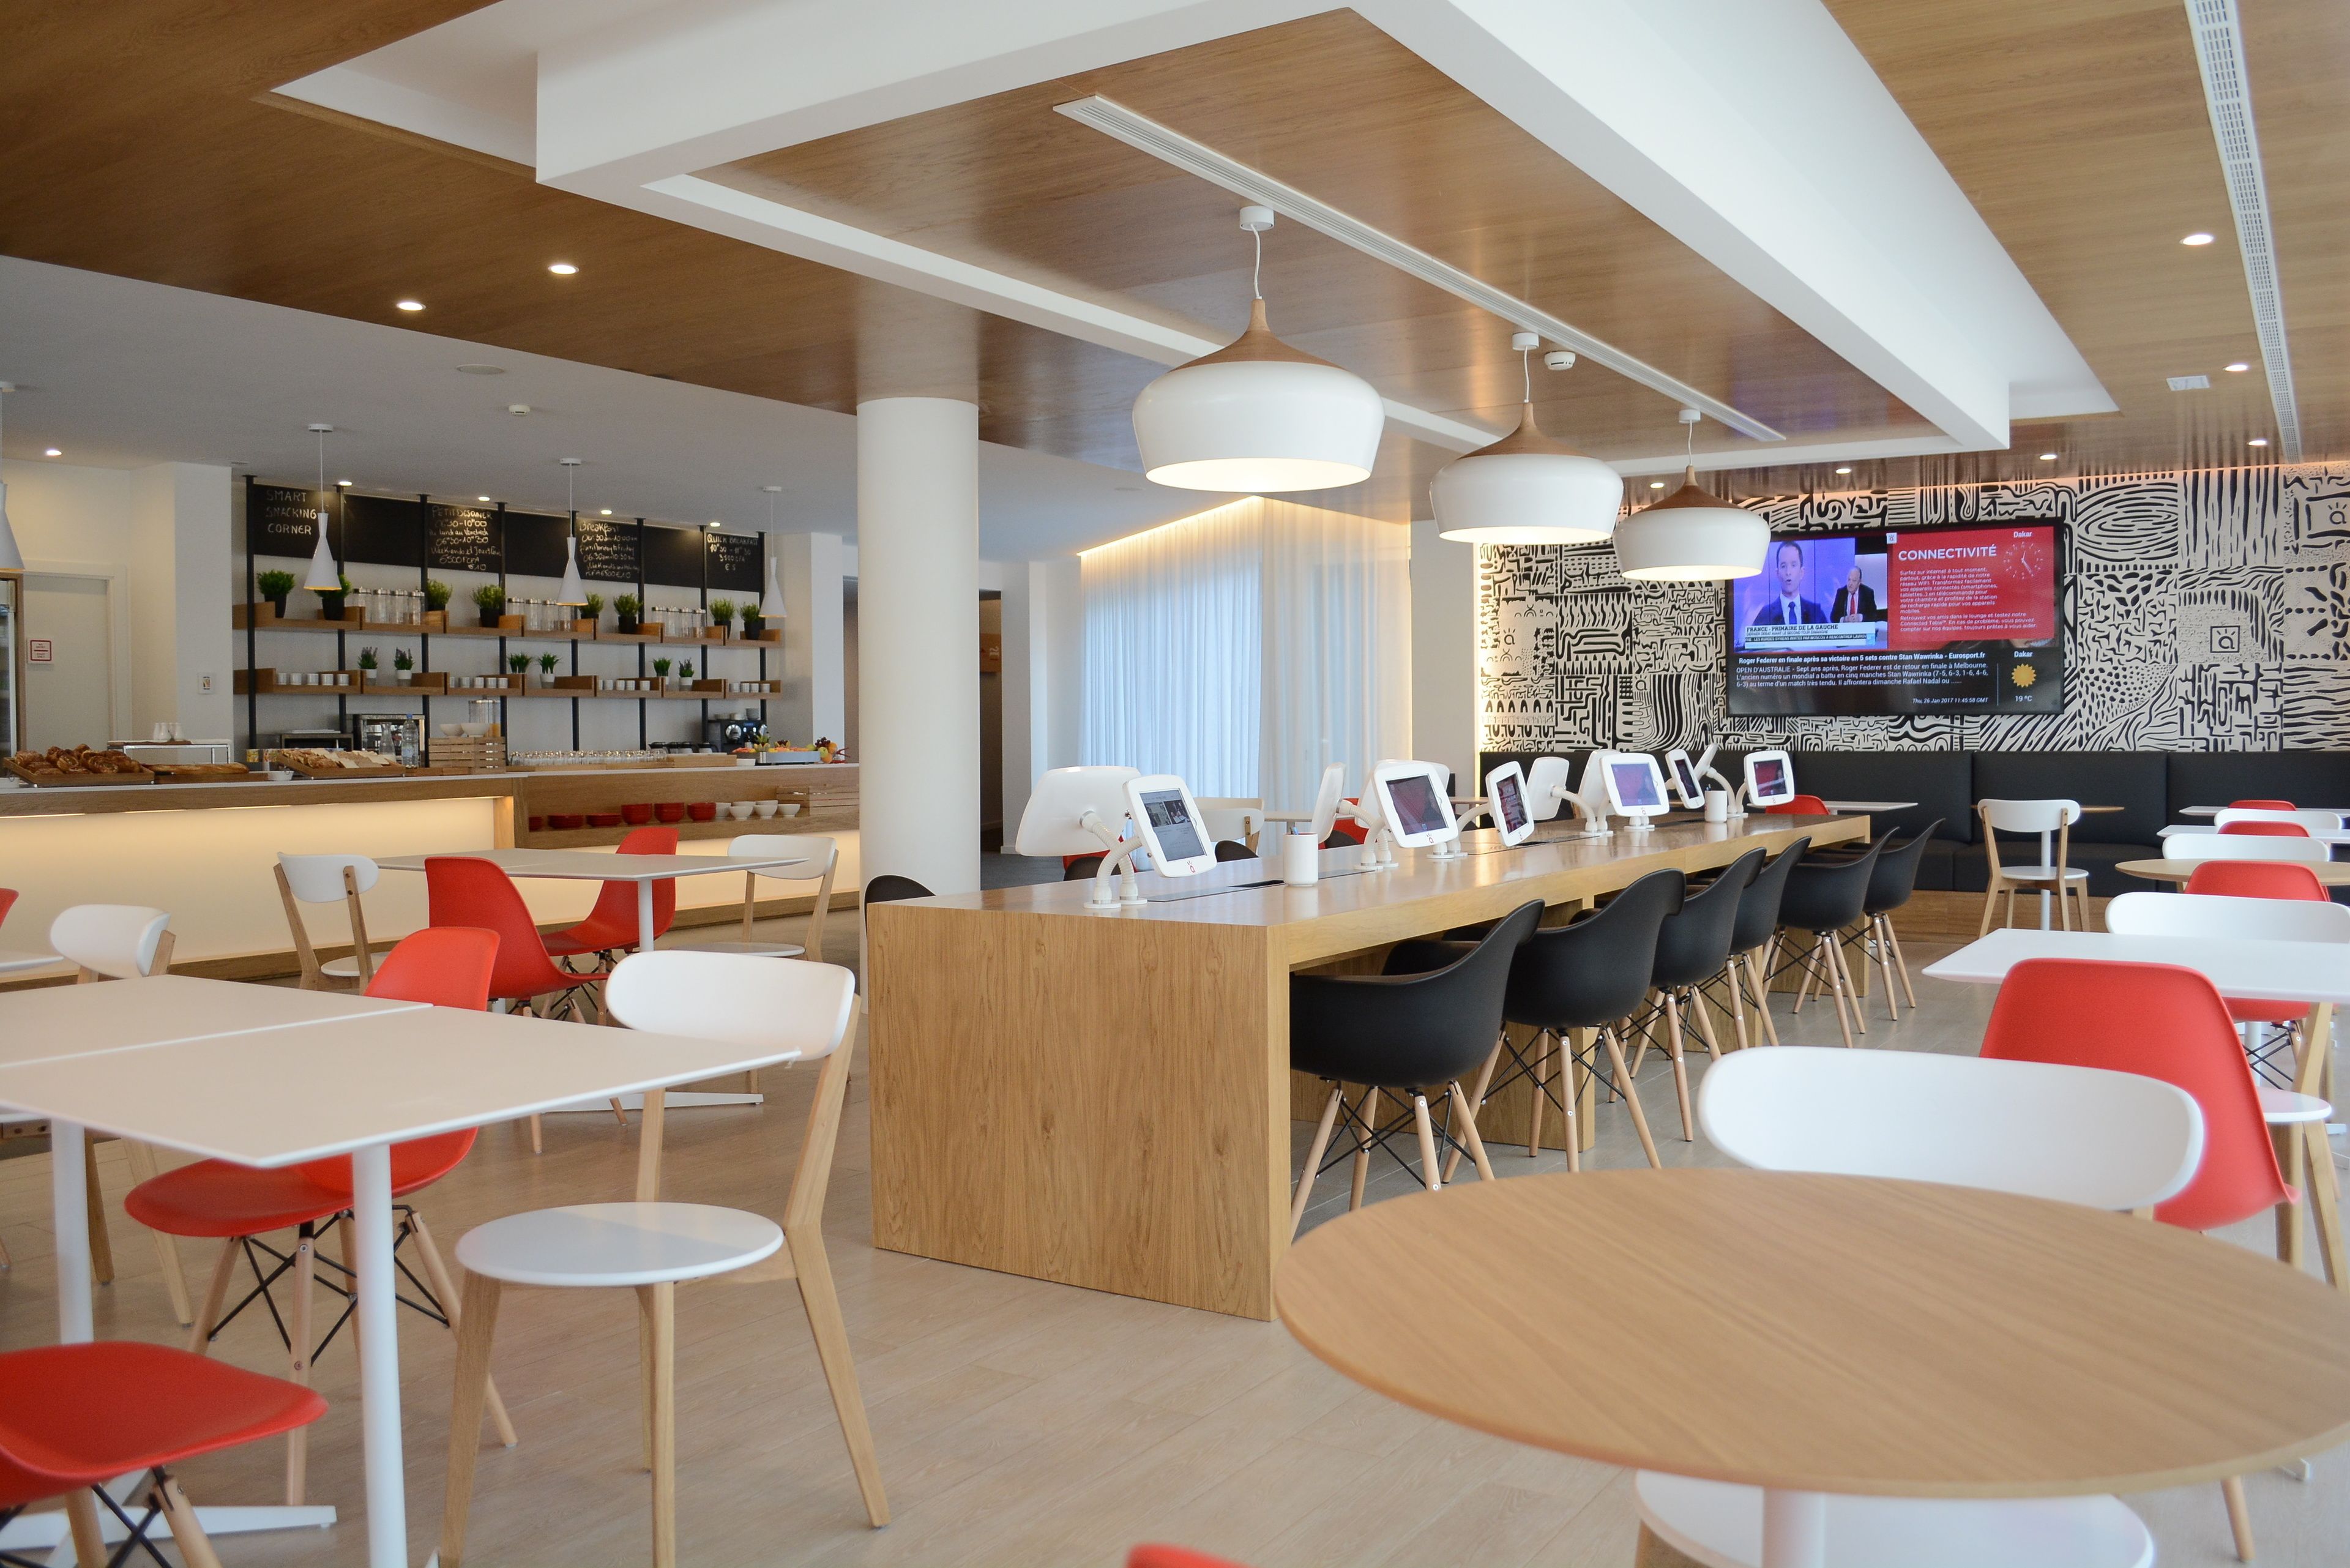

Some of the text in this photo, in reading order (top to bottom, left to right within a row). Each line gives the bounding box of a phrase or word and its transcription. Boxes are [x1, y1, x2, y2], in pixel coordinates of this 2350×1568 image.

[267, 490, 307, 502] SMART
[266, 506, 317, 519] SNACKING
[268, 523, 311, 535] CORNER
[707, 533, 727, 543] QUICK
[1898, 544, 1997, 561] CONNECTIVITÉ
